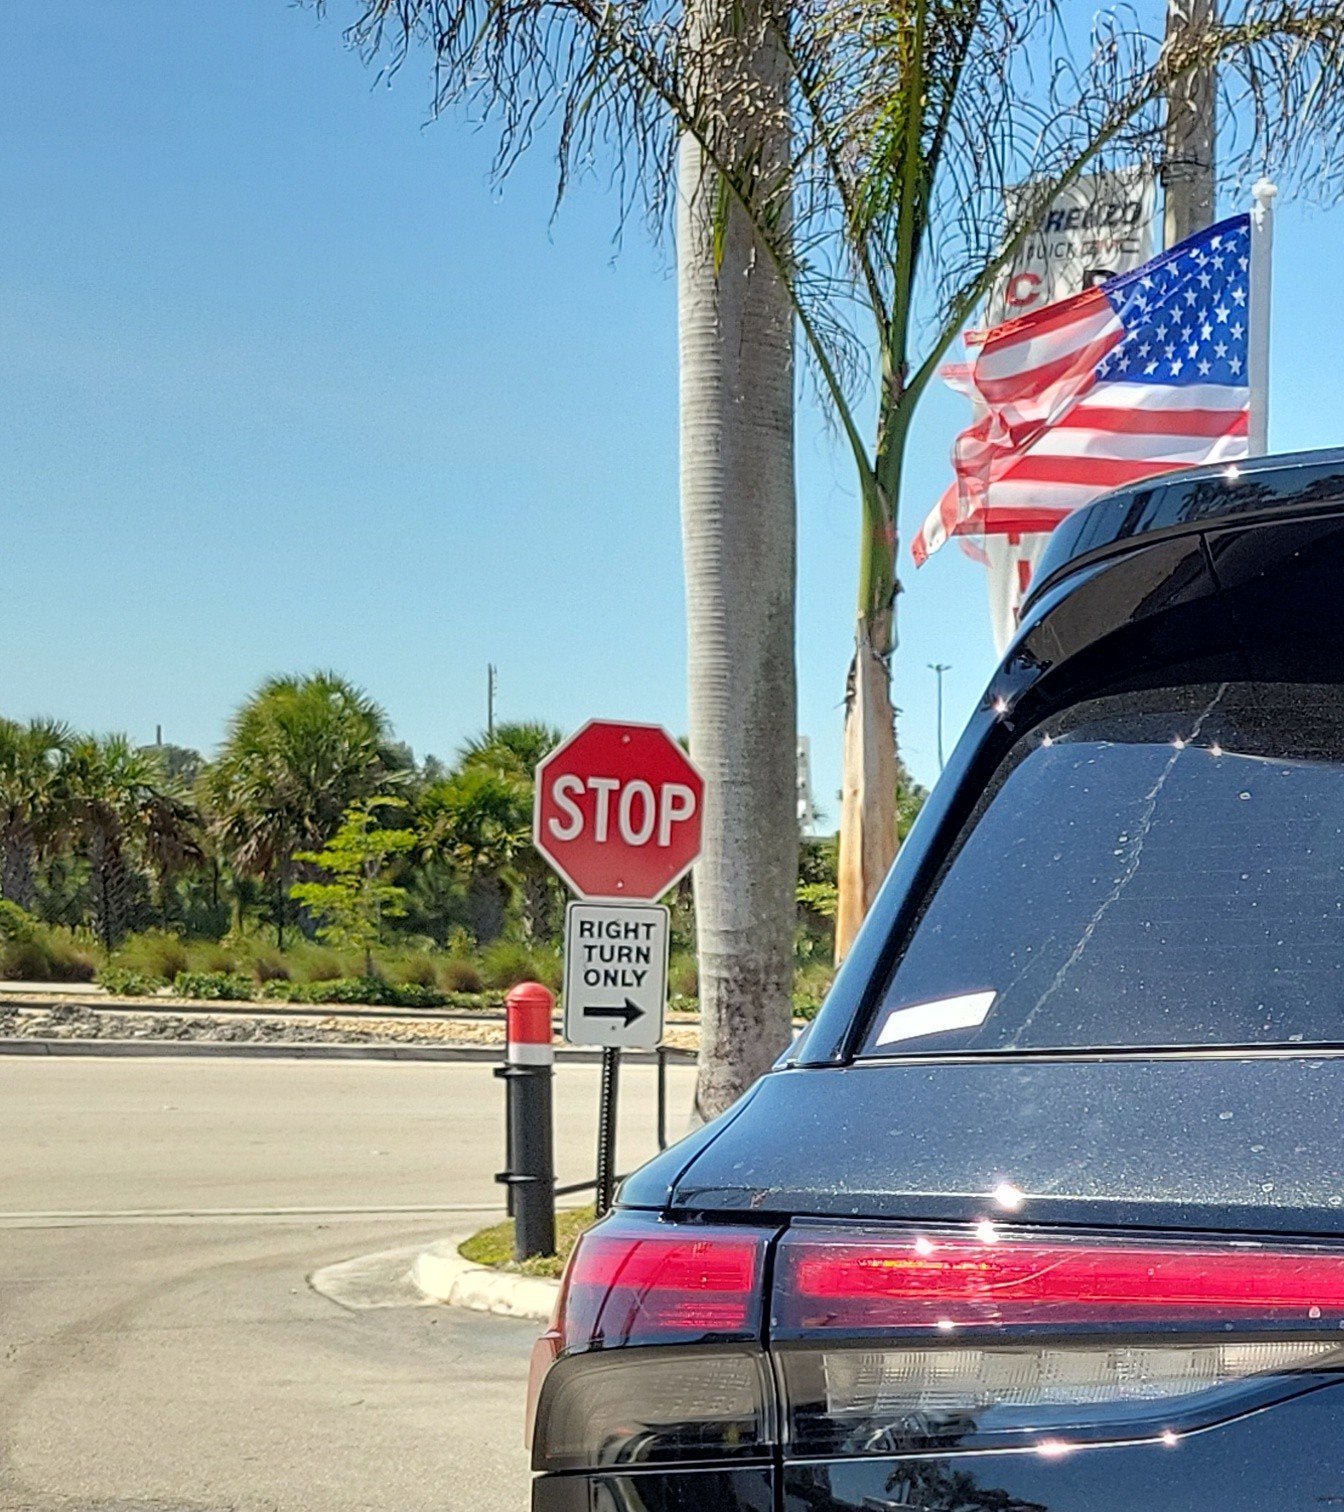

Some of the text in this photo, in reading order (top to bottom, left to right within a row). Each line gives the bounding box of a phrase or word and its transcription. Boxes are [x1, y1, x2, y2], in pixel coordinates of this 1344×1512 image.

[548, 774, 697, 847] STOP
[579, 920, 657, 940] RIGHT
[583, 945, 651, 964] TURN
[583, 968, 648, 988] ONLY
